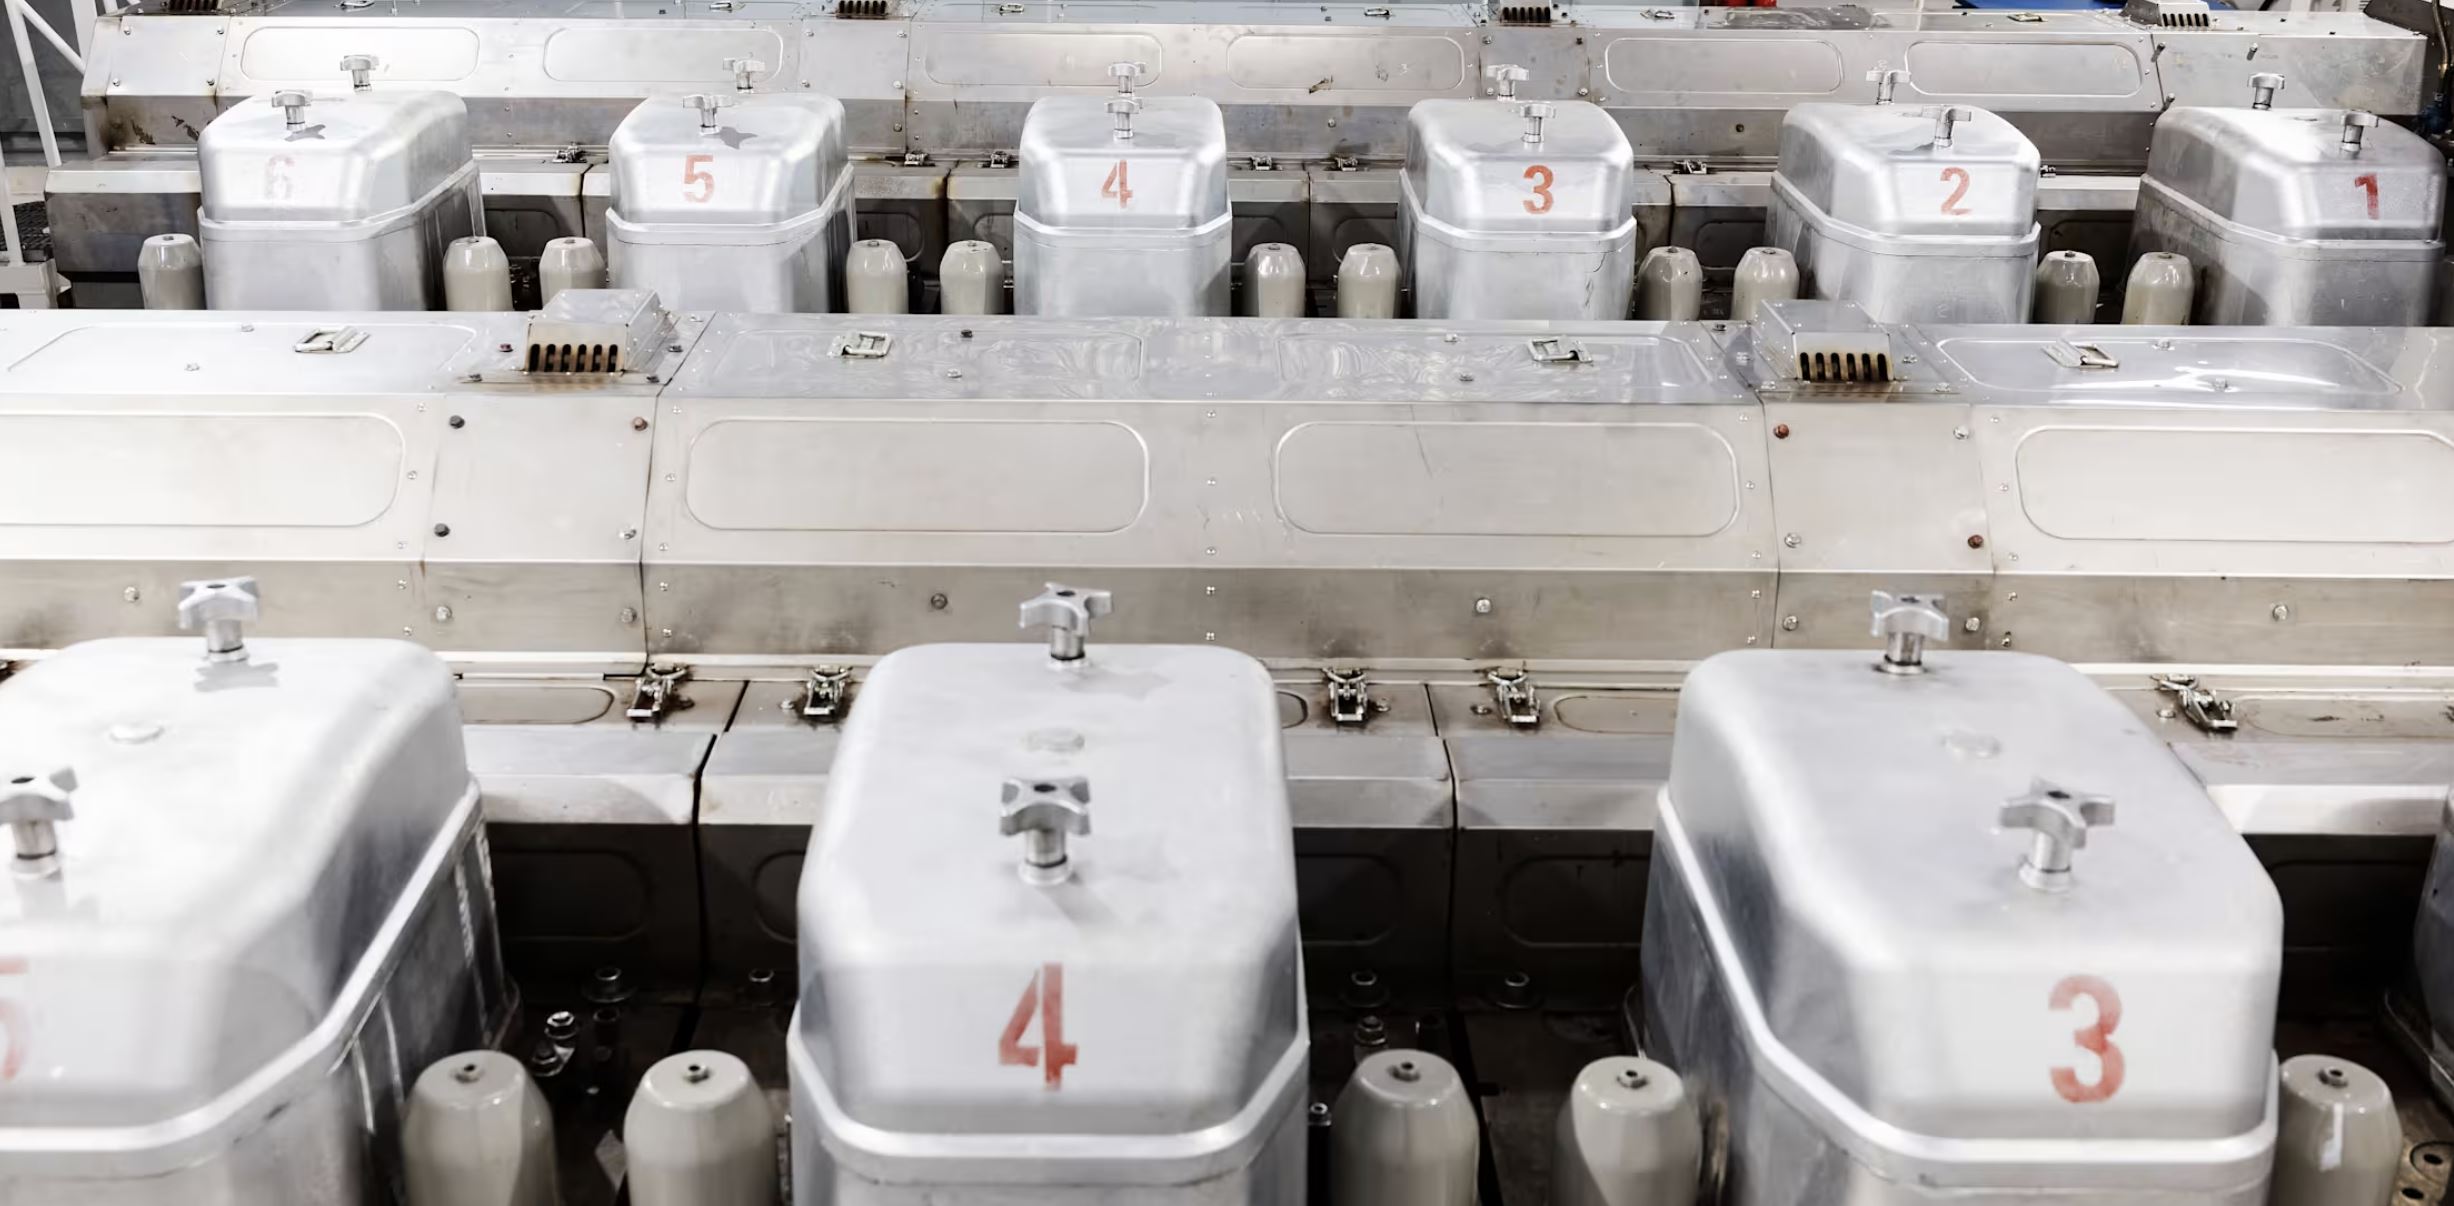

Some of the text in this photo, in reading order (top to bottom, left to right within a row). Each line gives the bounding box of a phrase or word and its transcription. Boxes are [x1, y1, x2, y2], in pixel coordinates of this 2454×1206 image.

[683, 154, 715, 203] 5
[1101, 160, 1133, 207] 4
[1522, 163, 1555, 215] 3
[1939, 166, 1970, 216] 2
[2354, 172, 2379, 220] 1
[998, 961, 1078, 1092] 4
[2048, 975, 2126, 1104] 3
